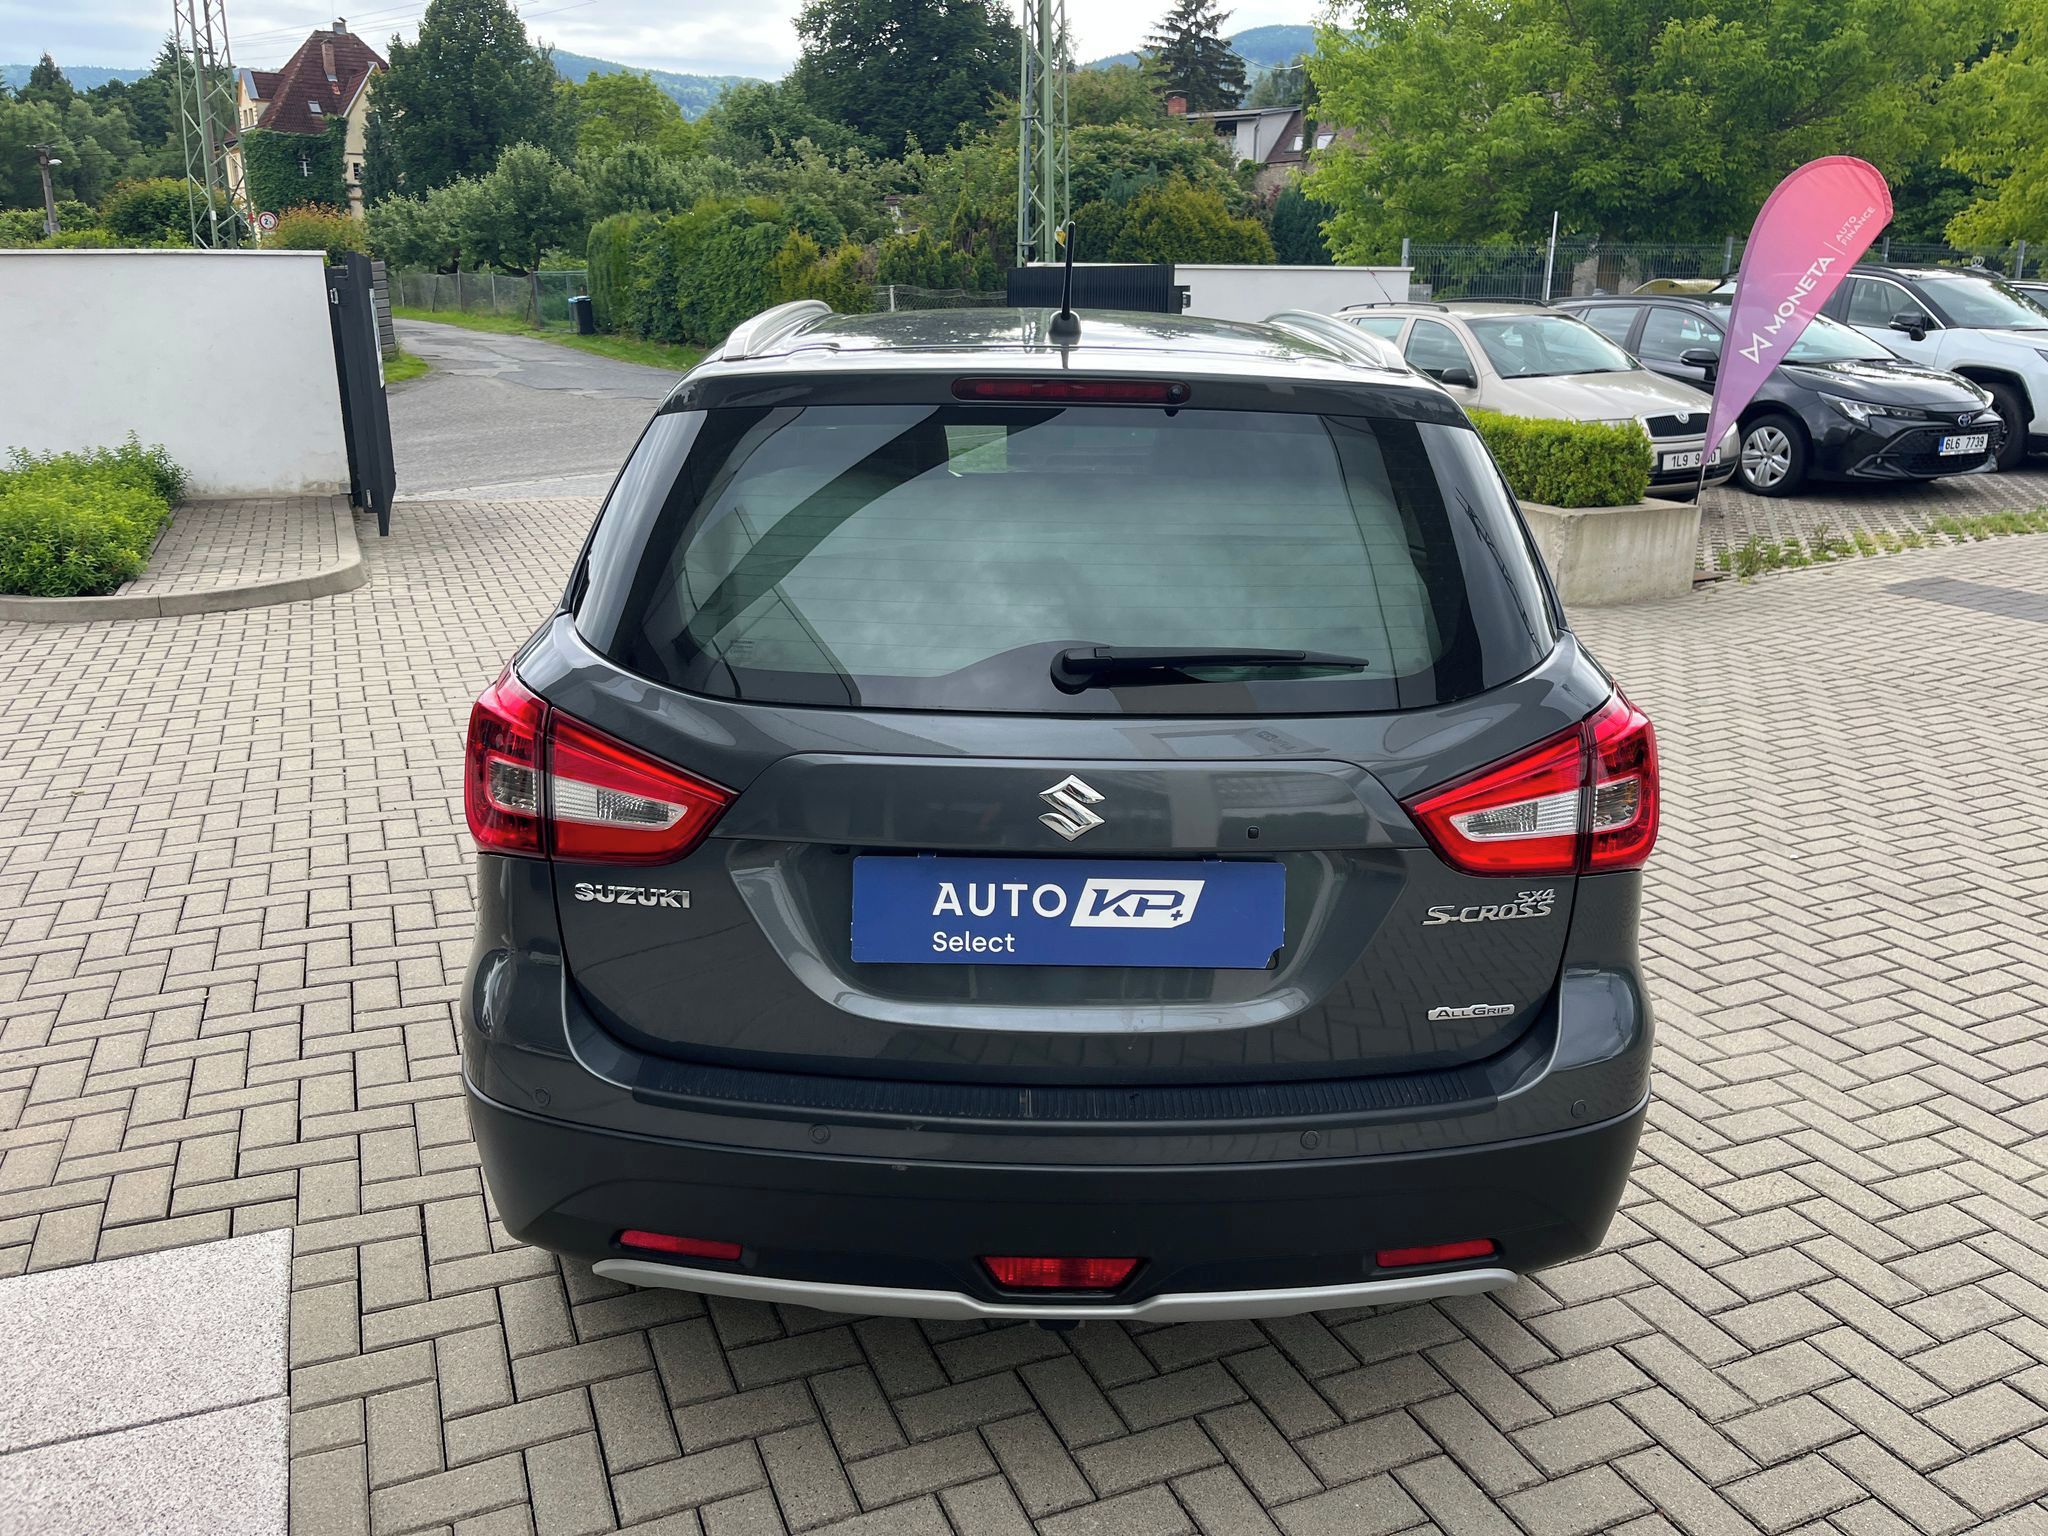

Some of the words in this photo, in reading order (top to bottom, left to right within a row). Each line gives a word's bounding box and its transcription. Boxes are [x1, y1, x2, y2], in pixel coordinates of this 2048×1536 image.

[1836, 215, 1857, 242] AUTO
[1841, 206, 1876, 246] FINANCE
[1763, 257, 1836, 335] MONETA
[1945, 438, 1961, 450] 6L6
[1671, 454, 1689, 468] 1L9
[574, 882, 690, 909] SUZUKI
[932, 882, 1067, 918] AUTO
[1513, 888, 1556, 903] SX4
[1422, 900, 1555, 926] S-CROSS
[932, 930, 1016, 953] Select
